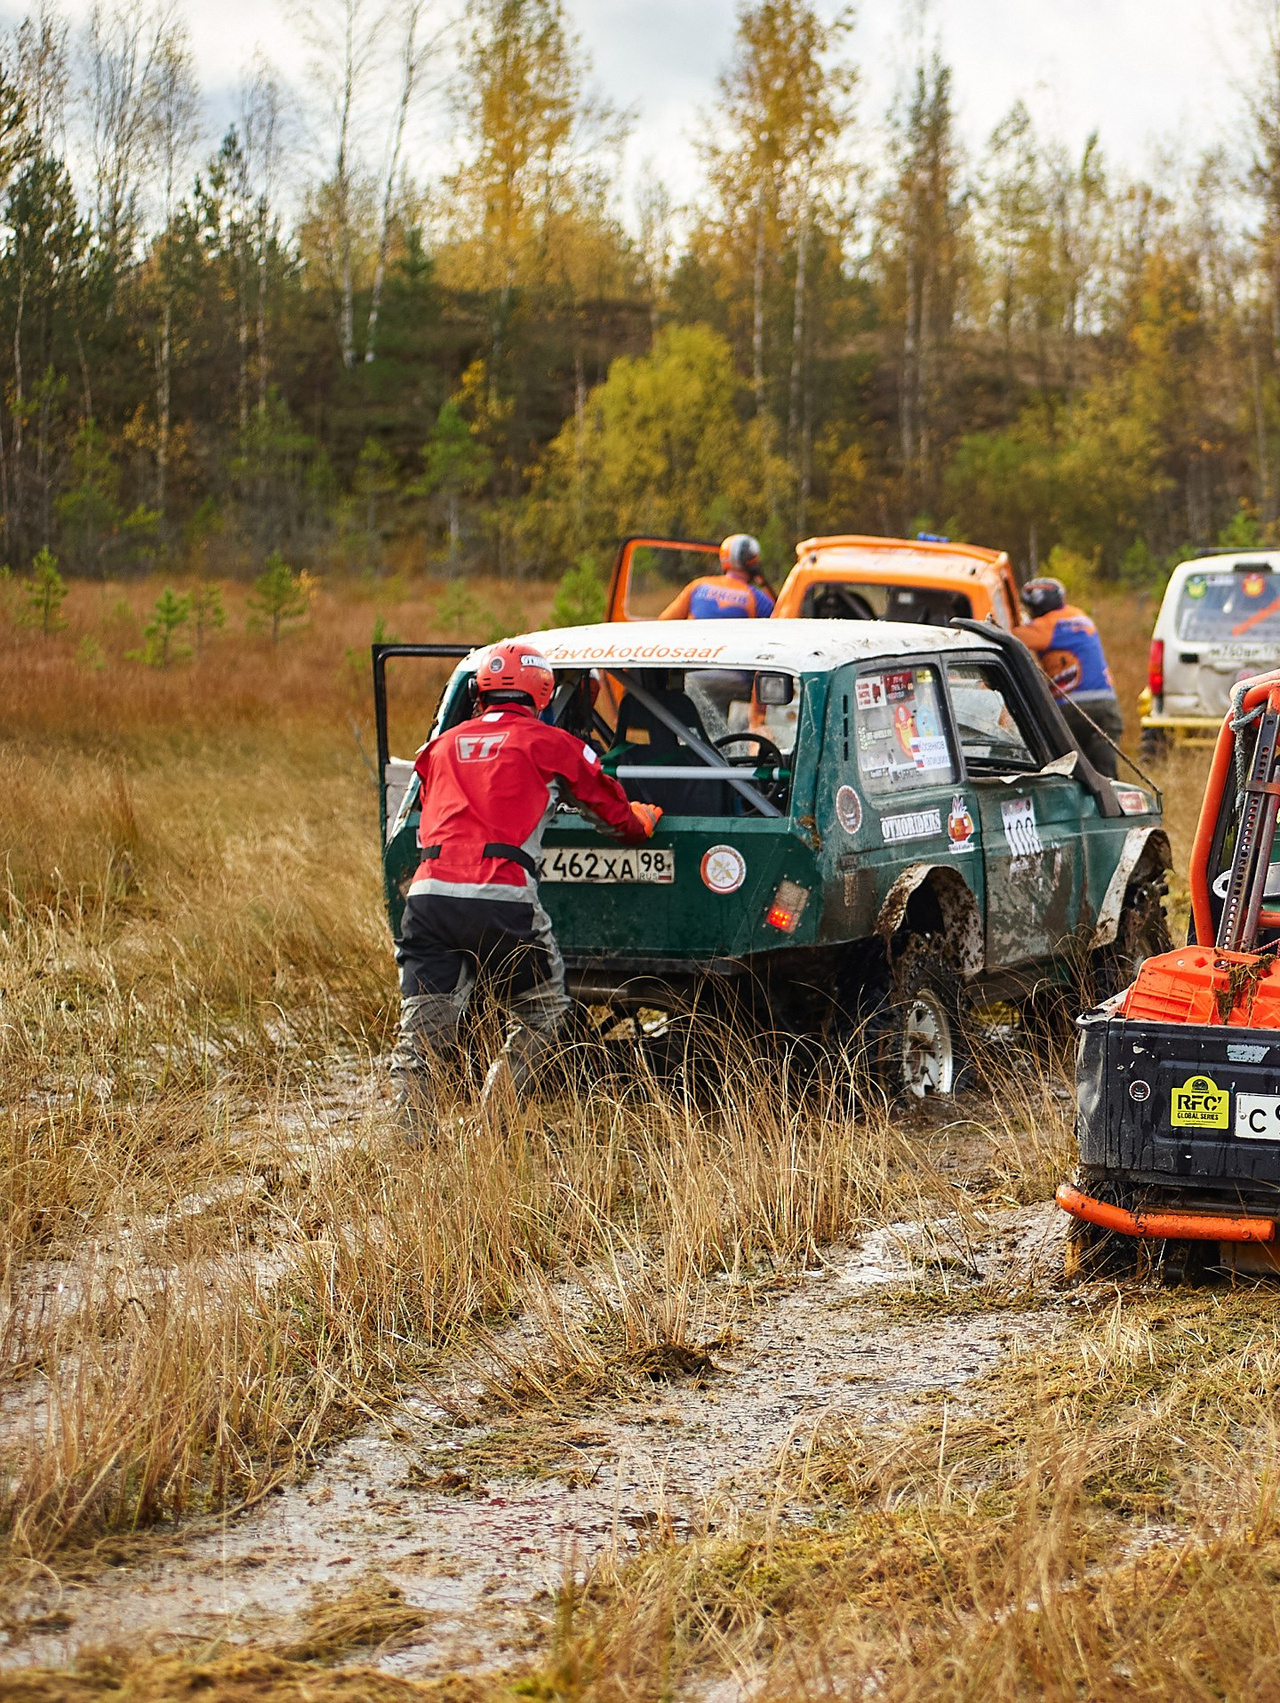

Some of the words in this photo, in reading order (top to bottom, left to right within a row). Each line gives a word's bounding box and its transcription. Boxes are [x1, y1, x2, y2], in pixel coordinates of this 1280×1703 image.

[459, 735, 506, 759] FT
[640, 852, 666, 872] 98
[1177, 1112, 1199, 1120] GLOBAL
[1200, 1113, 1219, 1121] SERIES
